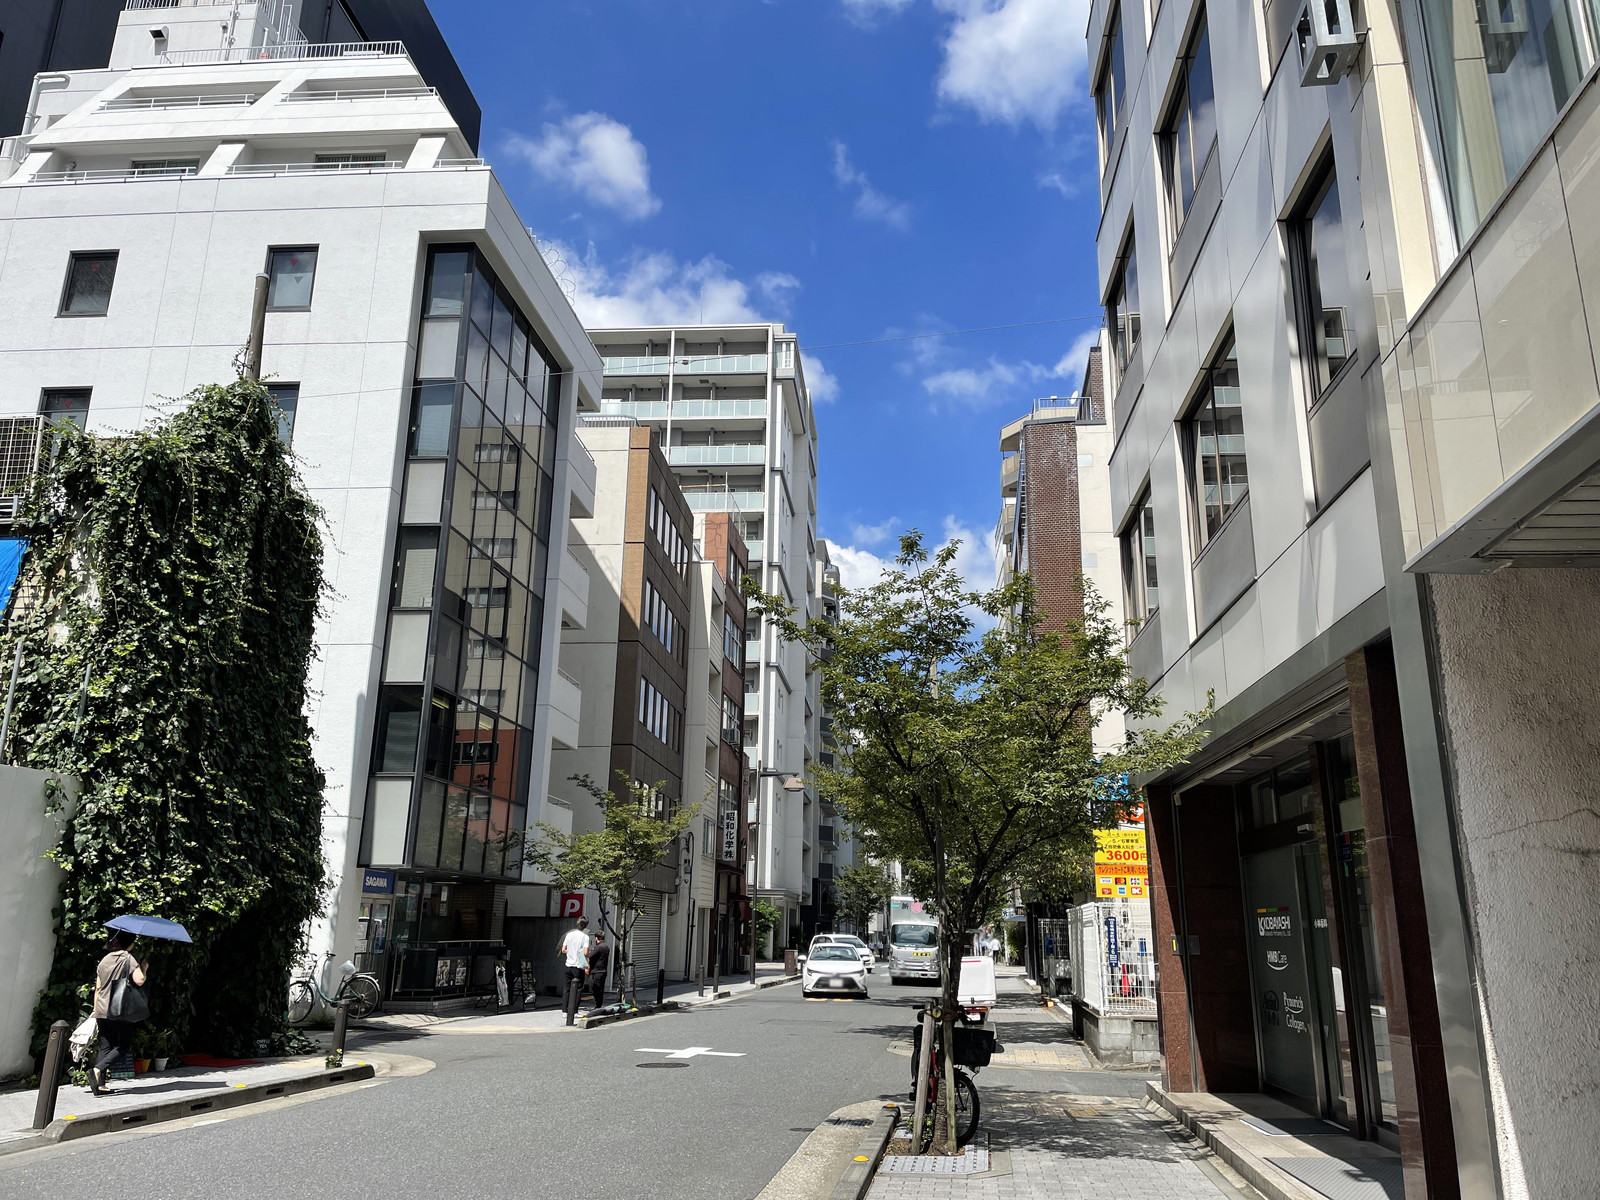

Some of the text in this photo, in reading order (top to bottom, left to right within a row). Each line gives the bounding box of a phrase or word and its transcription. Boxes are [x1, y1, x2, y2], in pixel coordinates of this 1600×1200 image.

[724, 812, 735, 859] 昭和化学株
[365, 876, 387, 888] SAGAWA
[563, 899, 580, 917] P
